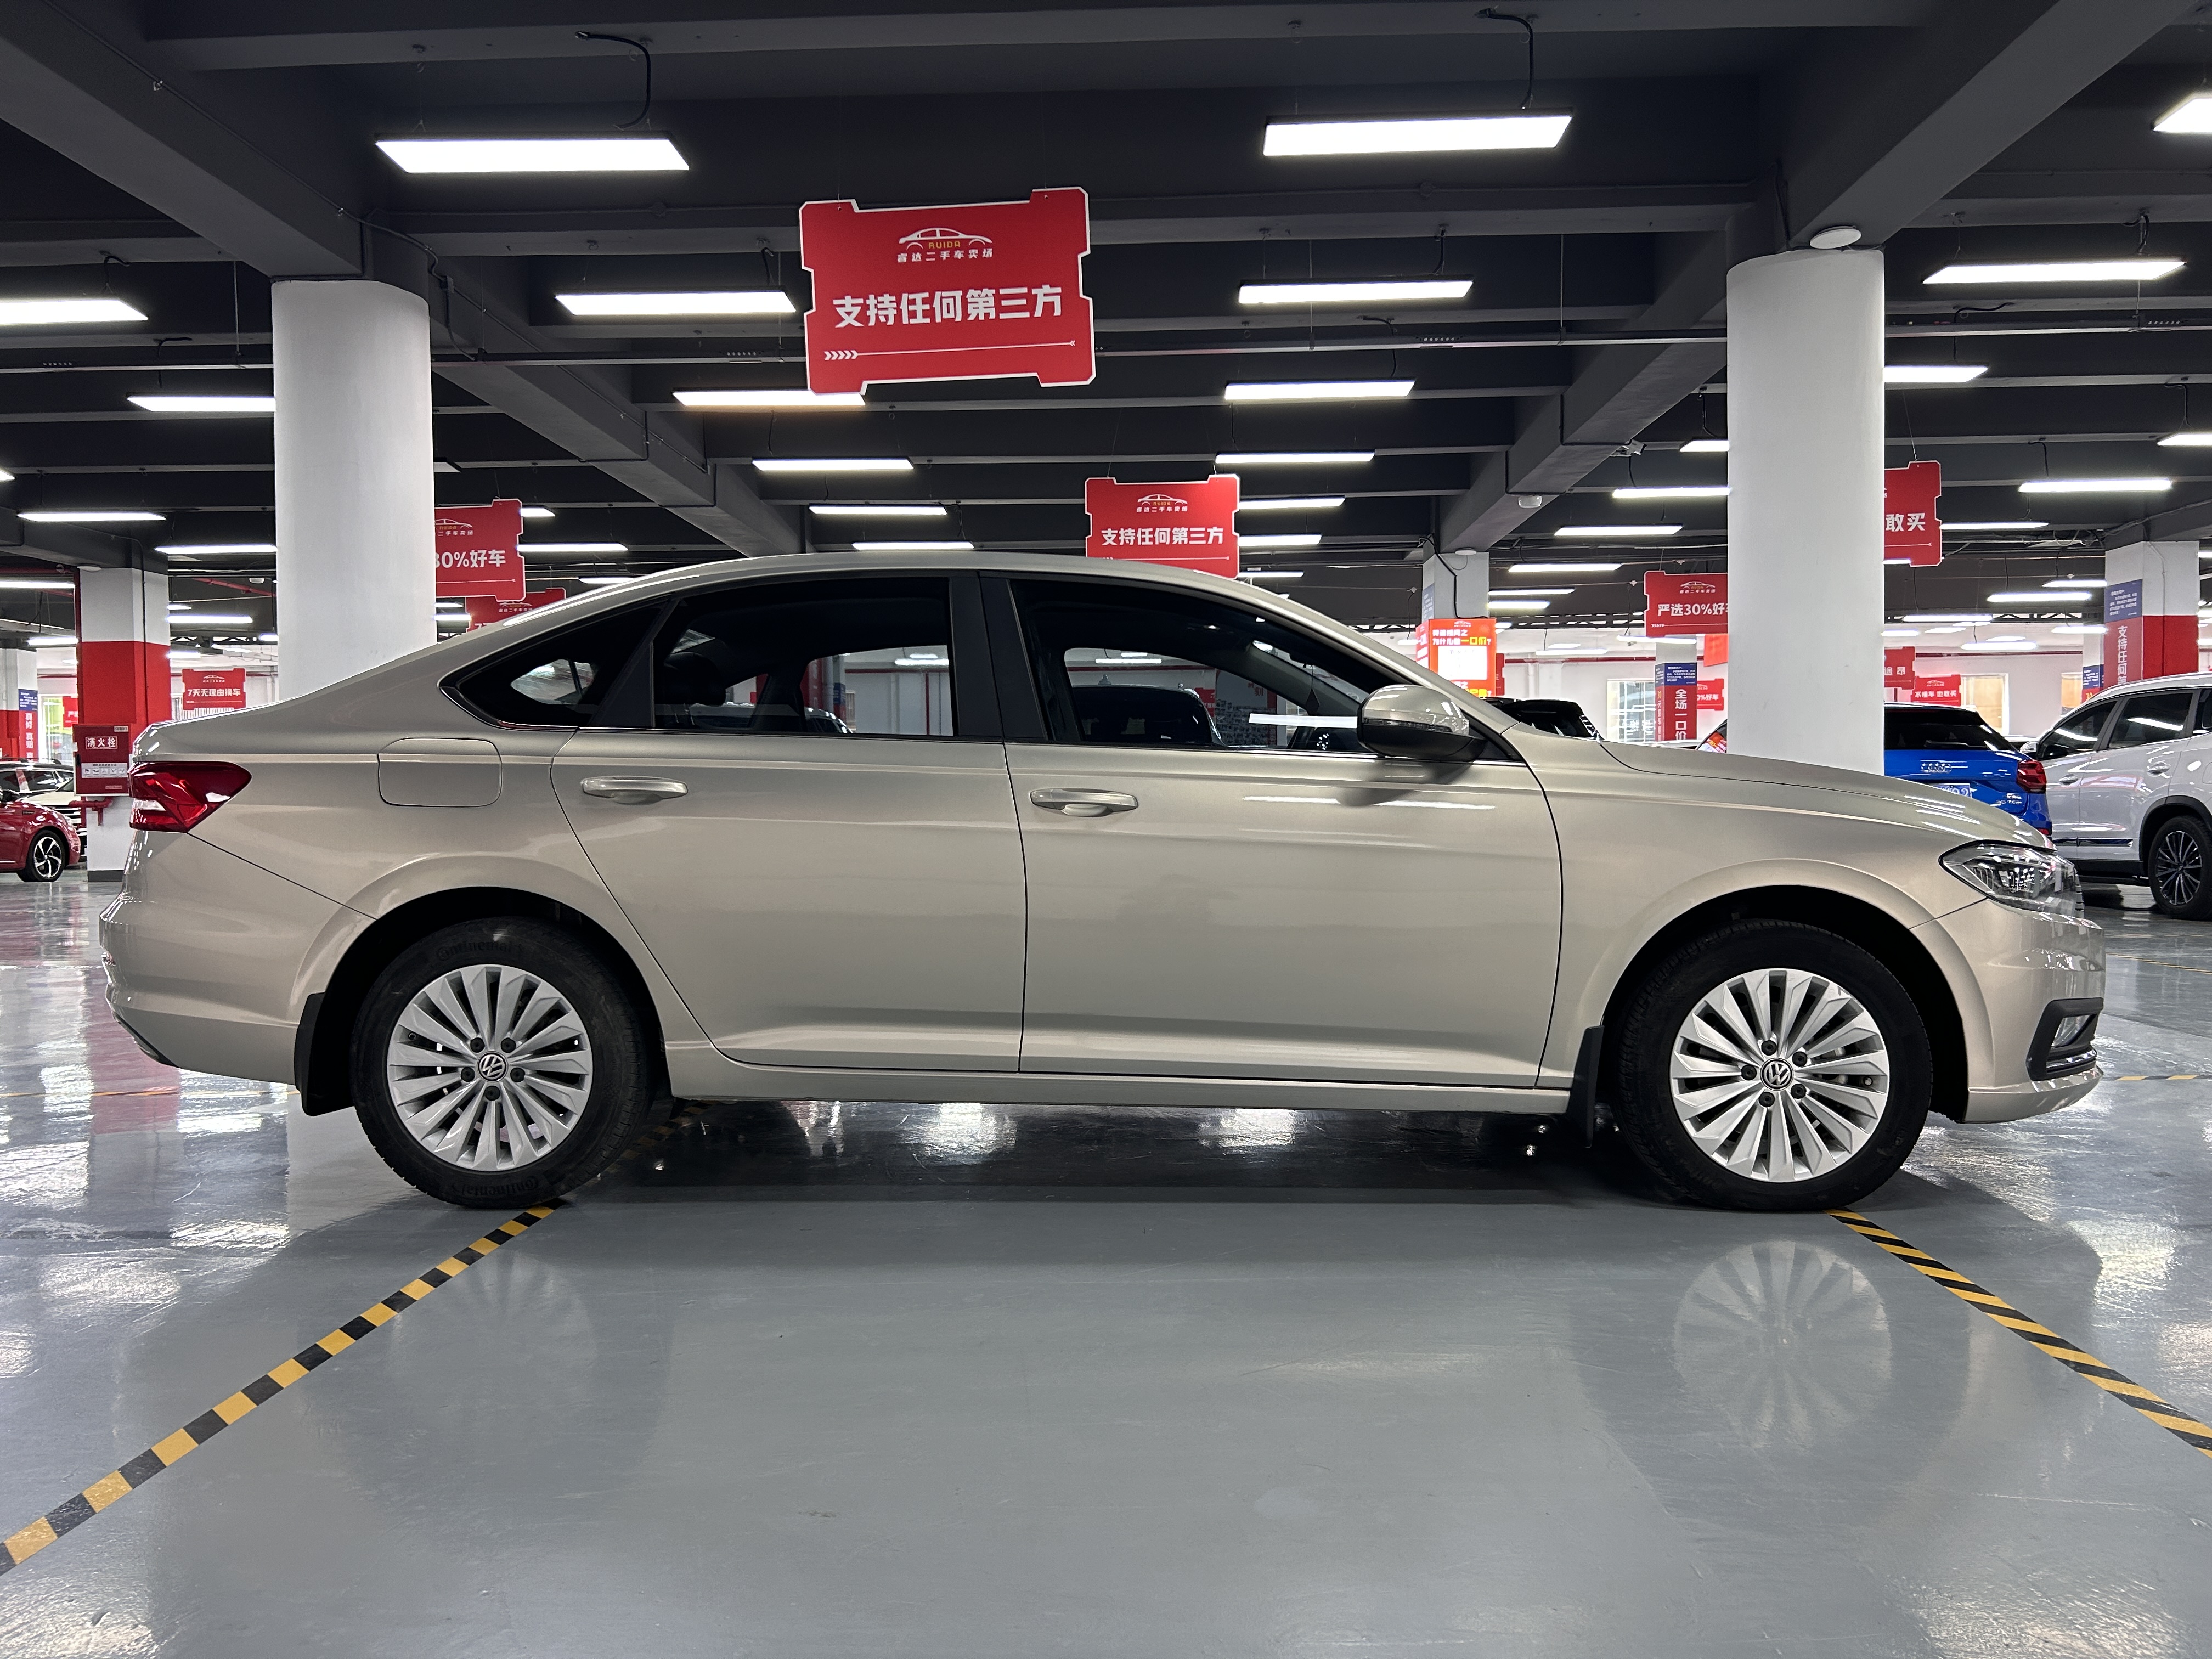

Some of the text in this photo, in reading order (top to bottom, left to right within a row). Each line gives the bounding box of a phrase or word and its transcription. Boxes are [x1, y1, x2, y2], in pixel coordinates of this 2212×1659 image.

[928, 240, 961, 249] RUIDA
[897, 247, 993, 263] 睿达二手车卖场
[832, 284, 1063, 328] 支持任何第三方
[1885, 512, 1926, 532] 敢买
[1101, 526, 1224, 546] 支持任何第三方
[1657, 602, 1728, 617] 严选30%好
[187, 688, 241, 697] 7天无理由换车
[1674, 689, 1688, 740] 全场一口价
[87, 737, 116, 747] 消火栓
